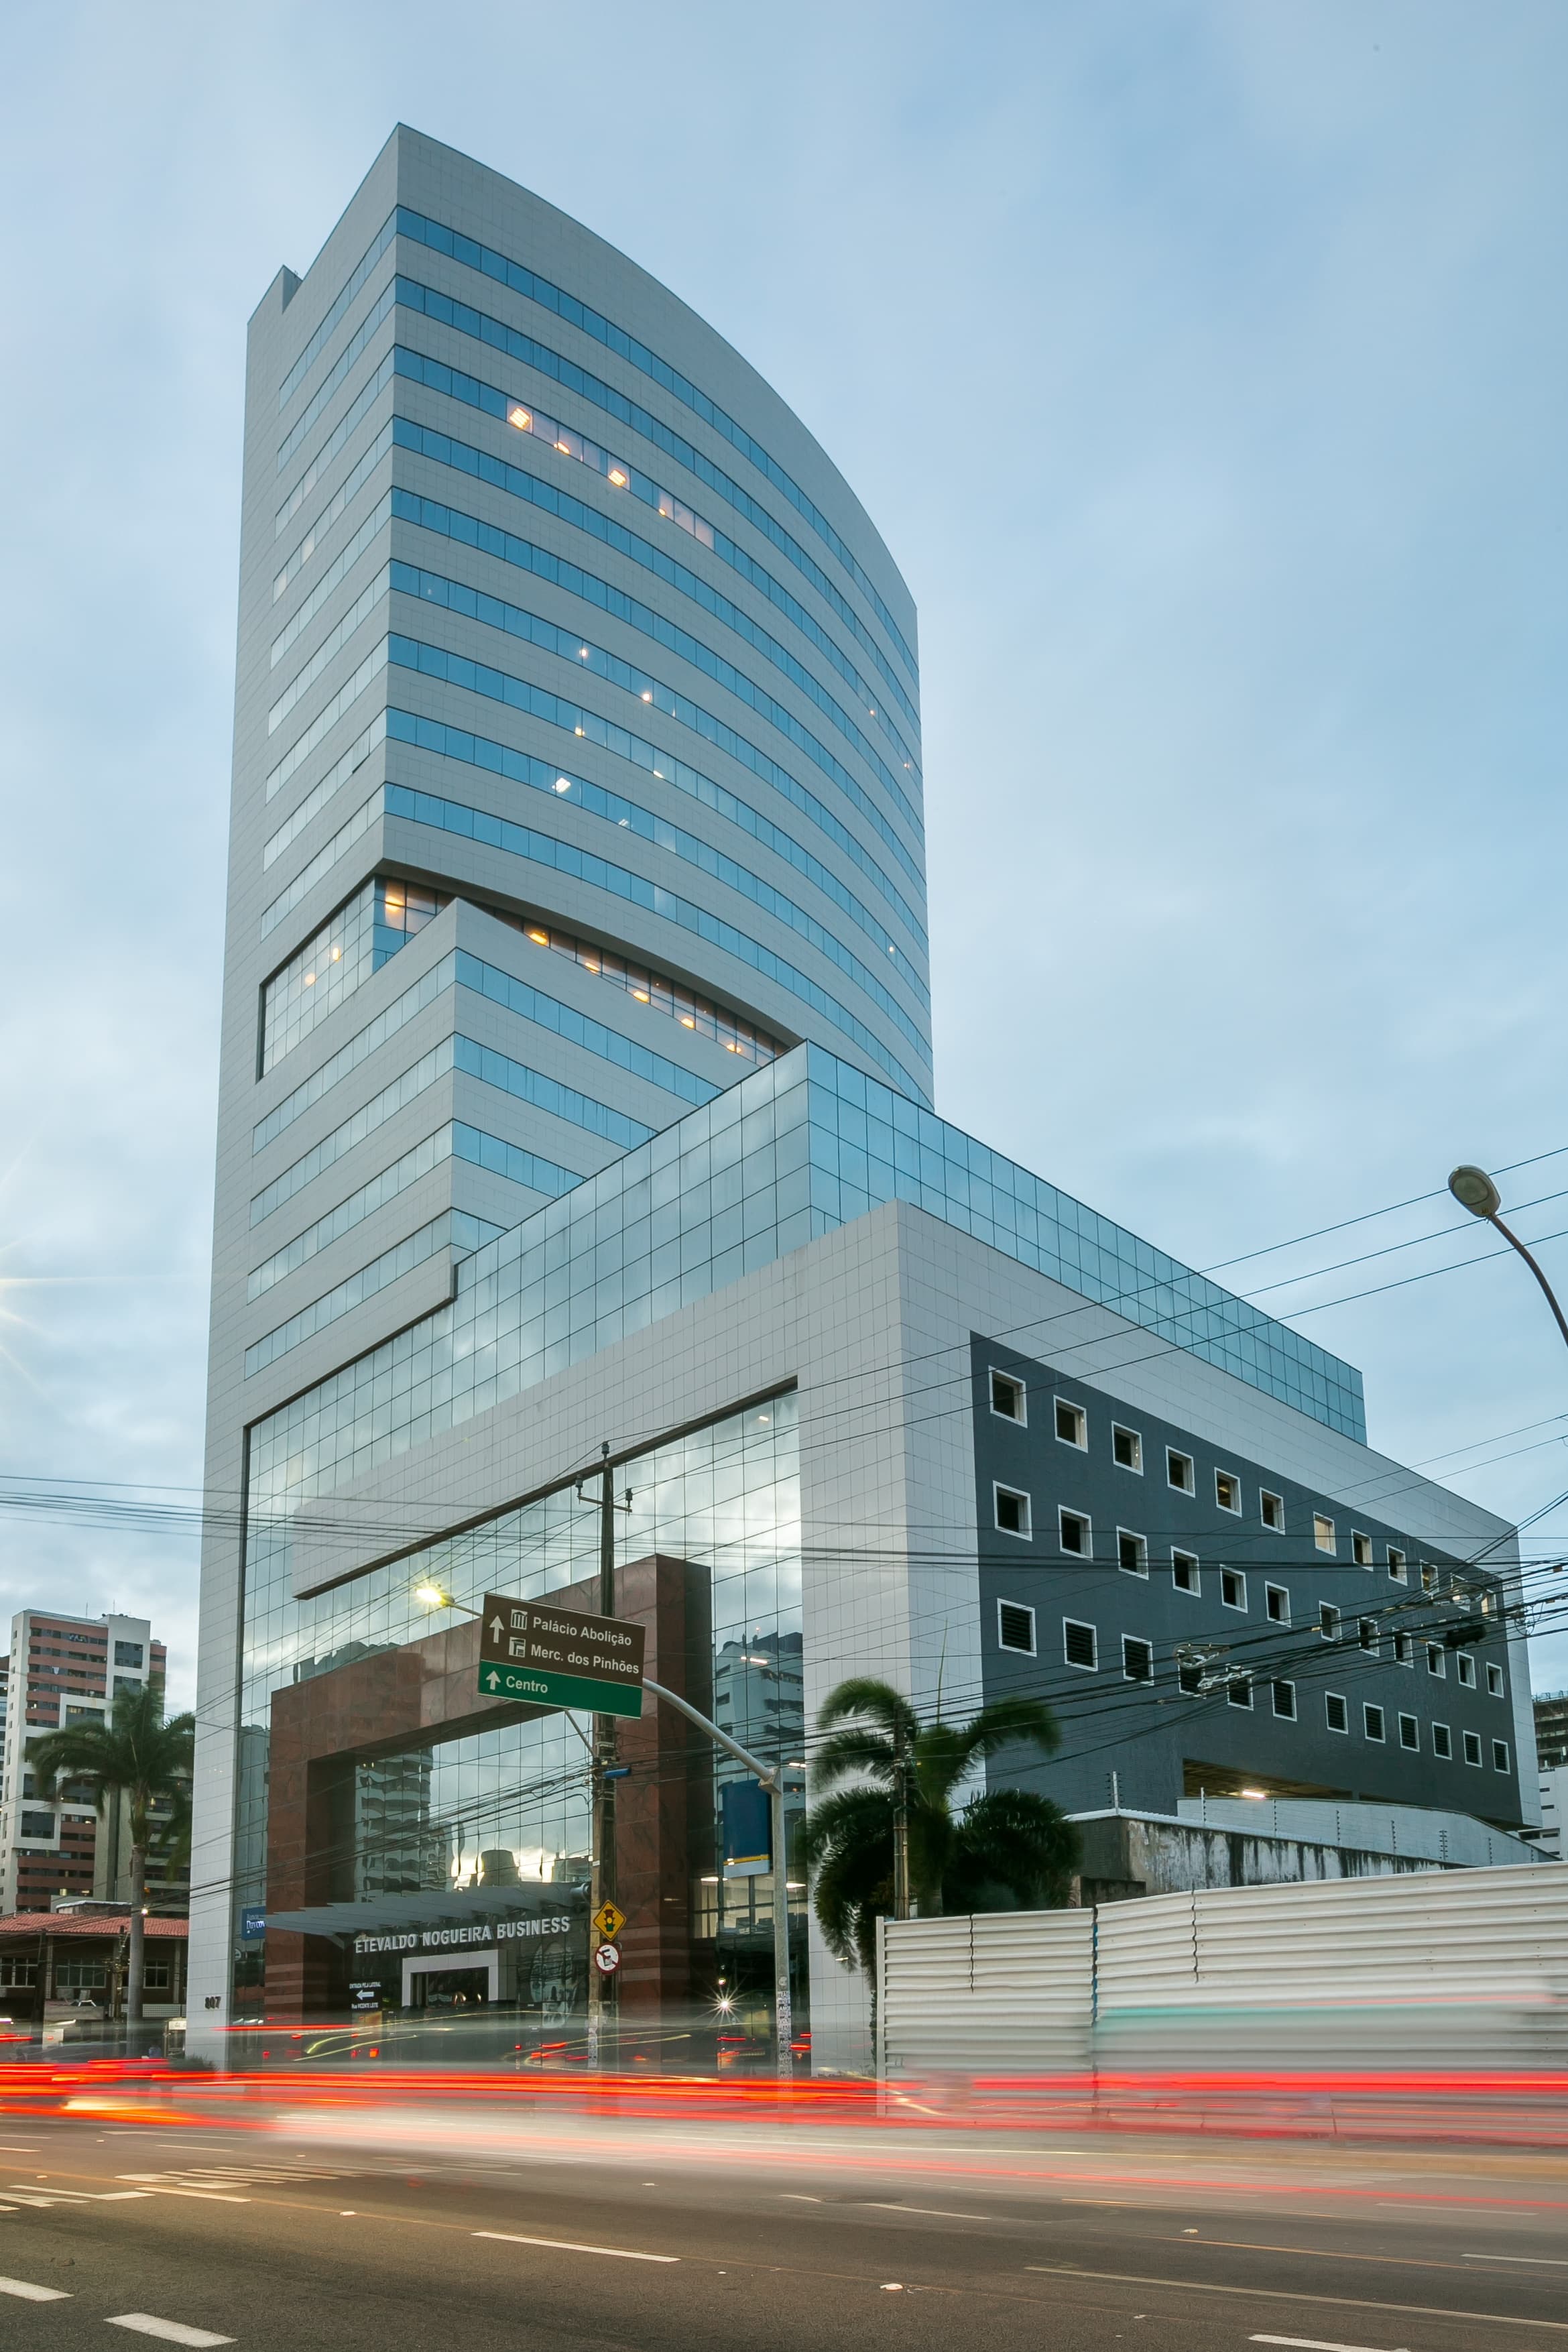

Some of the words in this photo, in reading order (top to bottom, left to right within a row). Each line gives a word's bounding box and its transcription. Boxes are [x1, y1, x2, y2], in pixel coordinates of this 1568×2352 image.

[533, 1616, 577, 1636] Palácio
[581, 1627, 632, 1646] Abolição
[531, 1644, 564, 1661] Merc.
[568, 1652, 589, 1667] dos
[593, 1655, 640, 1674] Pinhões
[506, 1675, 548, 1694] Centro
[355, 1934, 418, 1954] ETEVALDO
[422, 1925, 493, 1946] NOGUEIRA
[497, 1916, 570, 1940] BUSINESS
[204, 1996, 221, 2009] 807
[115, 2162, 442, 2189] SINAL
